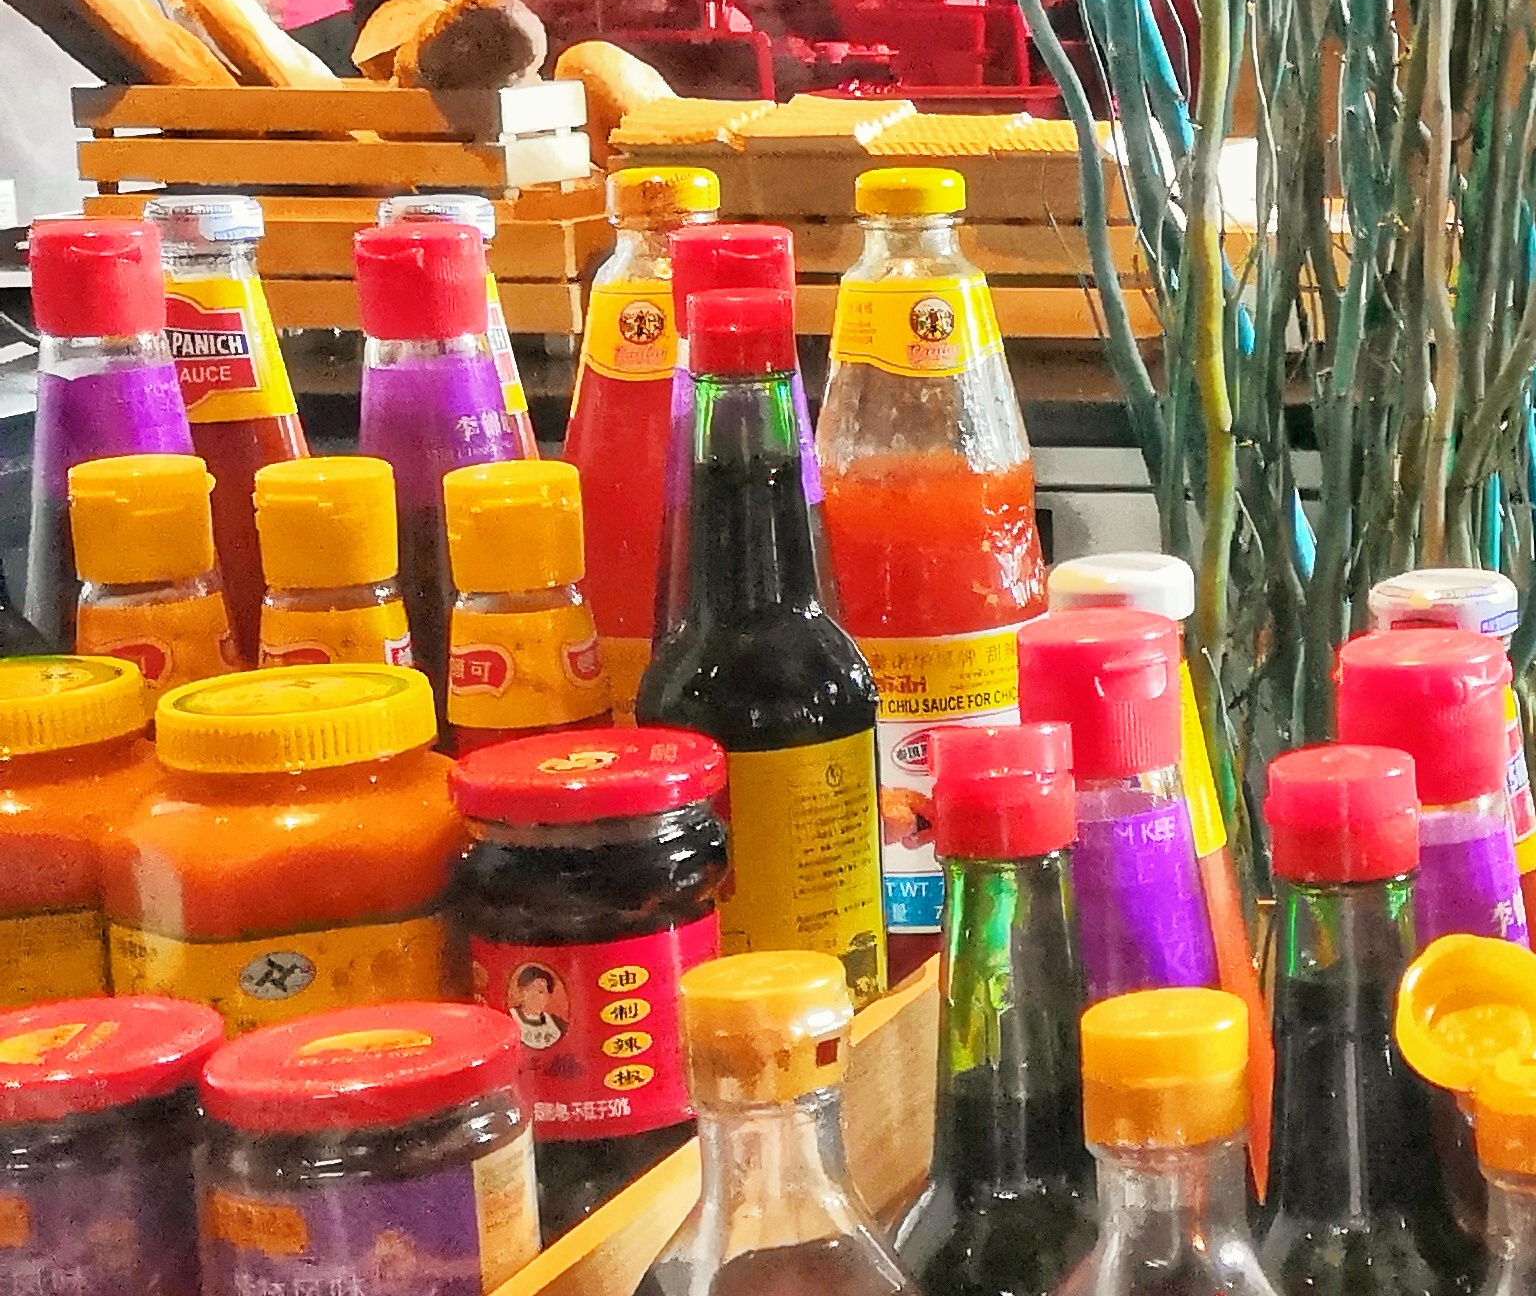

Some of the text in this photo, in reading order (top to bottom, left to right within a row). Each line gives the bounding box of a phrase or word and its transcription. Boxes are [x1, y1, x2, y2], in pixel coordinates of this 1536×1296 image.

[172, 331, 244, 356] PANICH
[179, 364, 233, 384] AUCE
[922, 695, 965, 713] SAUCE
[967, 692, 992, 709] FOR
[993, 686, 1017, 704] CHIC
